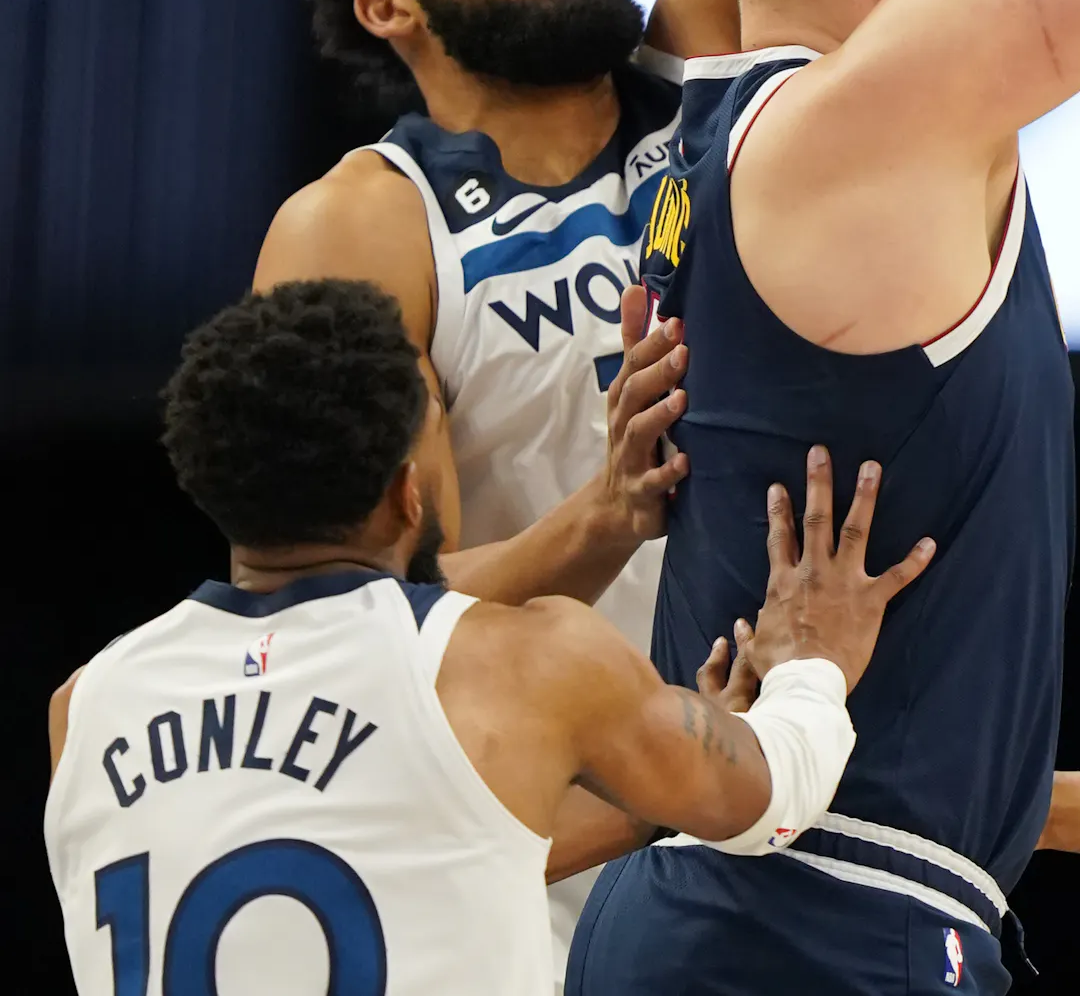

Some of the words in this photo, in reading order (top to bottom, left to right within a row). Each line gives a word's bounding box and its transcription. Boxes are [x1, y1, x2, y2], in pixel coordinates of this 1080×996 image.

[454, 177, 491, 214] 6
[102, 690, 379, 808] CONLEY
[94, 838, 388, 996] 10
